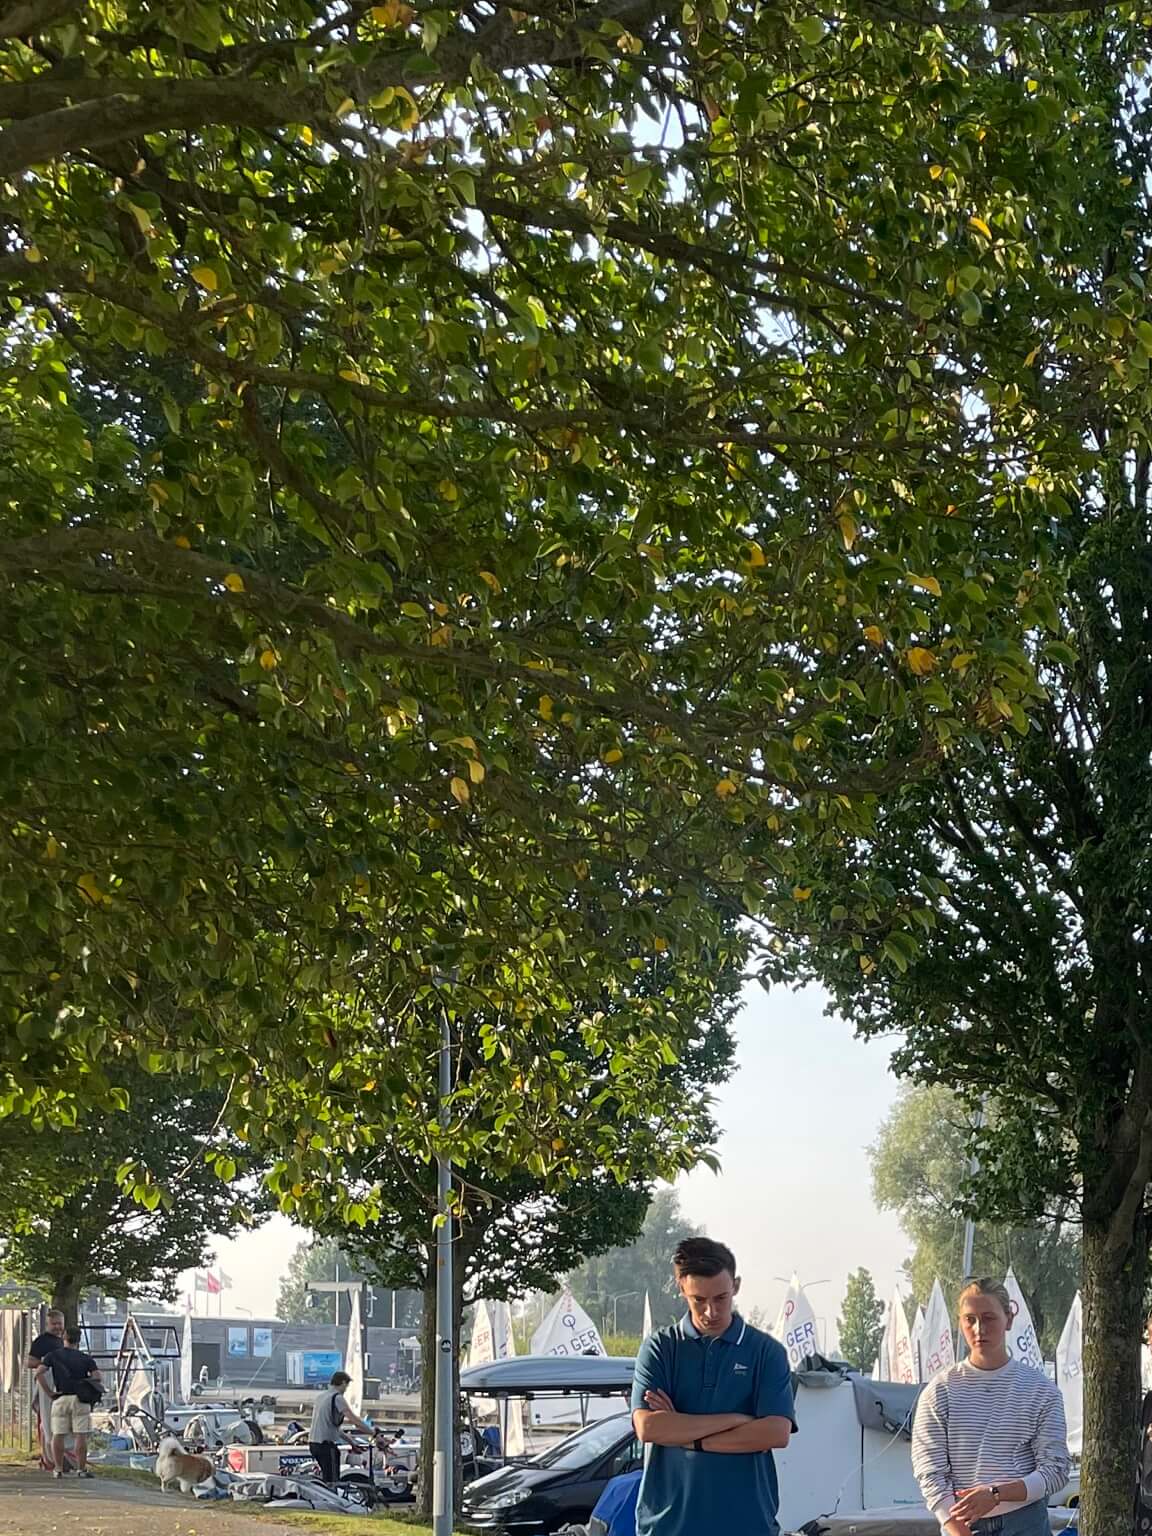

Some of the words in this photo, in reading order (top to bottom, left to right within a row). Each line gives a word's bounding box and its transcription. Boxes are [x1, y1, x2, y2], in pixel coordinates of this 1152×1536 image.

[570, 1330, 598, 1352] GER
[786, 1321, 815, 1347] GER
[897, 1336, 909, 1356] ER
